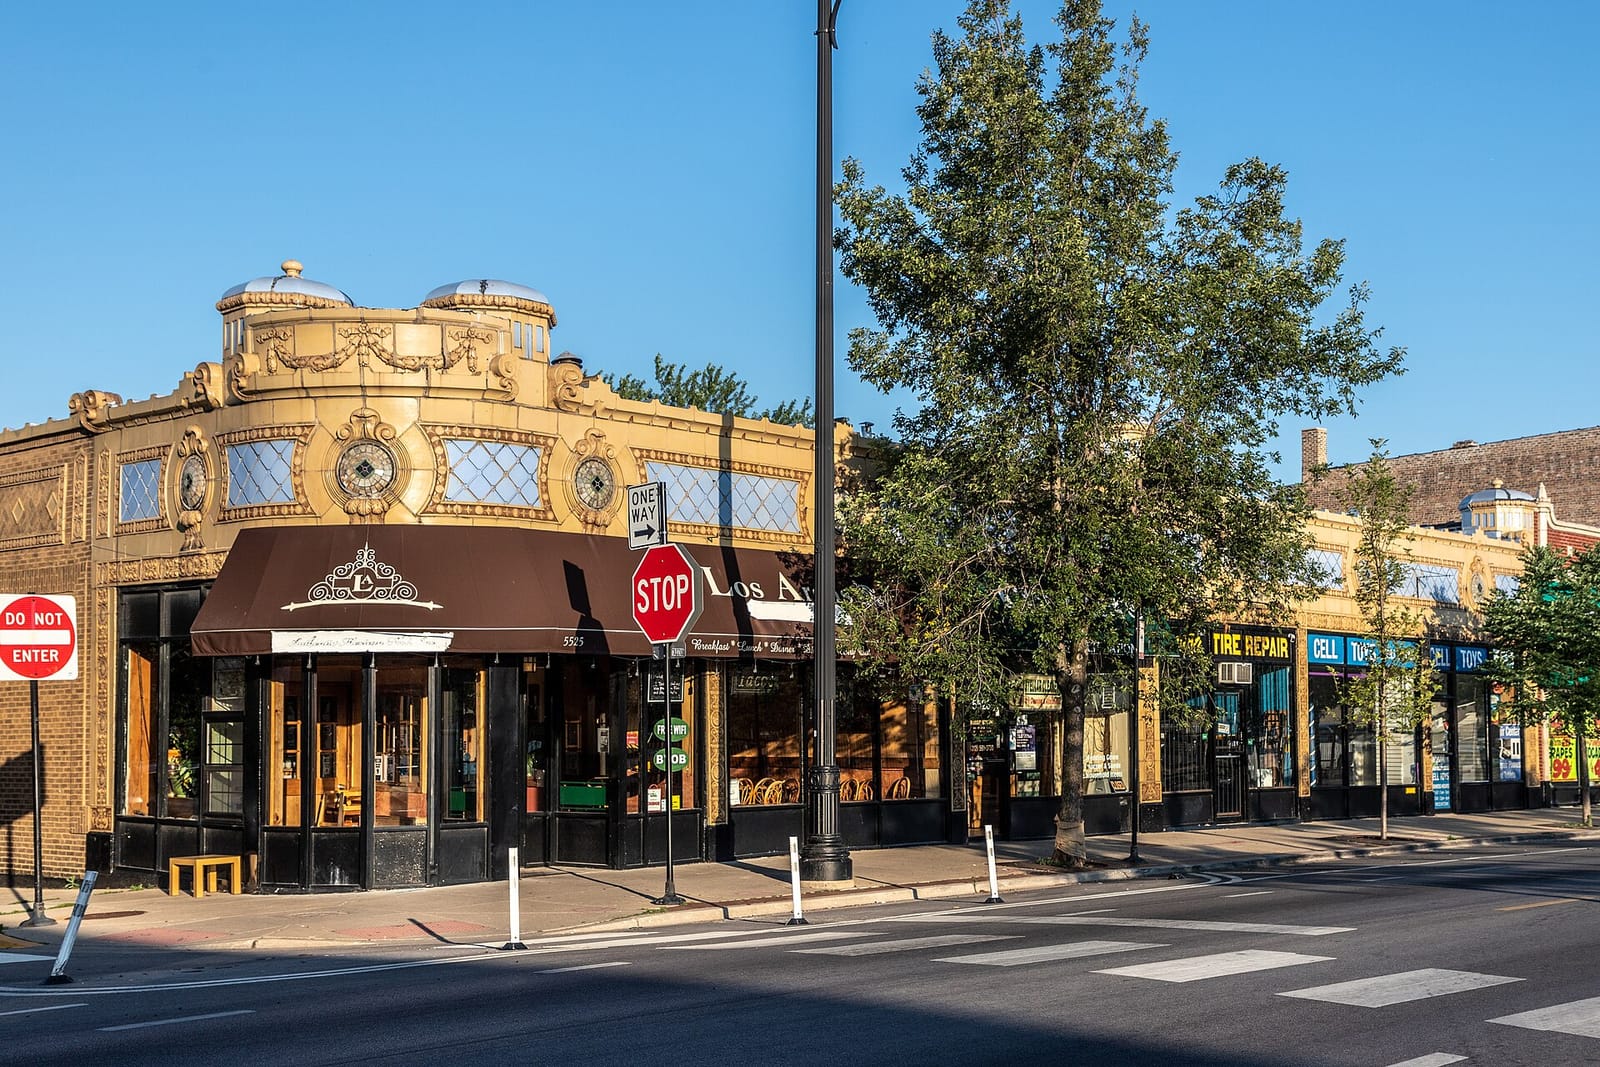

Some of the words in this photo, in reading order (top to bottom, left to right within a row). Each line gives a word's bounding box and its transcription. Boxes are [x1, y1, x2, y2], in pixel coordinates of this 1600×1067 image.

[631, 488, 656, 506] ONE
[631, 505, 656, 524] WAY
[700, 566, 765, 598] Los
[637, 574, 689, 614] STOP
[5, 612, 26, 626] DO
[34, 612, 63, 626] NOT
[562, 635, 584, 648] 5525
[691, 638, 730, 654] Breakfast
[737, 641, 763, 653] Lunch
[770, 642, 796, 654] Dinner
[1213, 633, 1242, 656] TIRE
[1245, 634, 1290, 659] REPAIR
[1313, 638, 1339, 659] CELL
[12, 649, 59, 663] ENTER
[1460, 649, 1483, 669] TOYS
[674, 725, 687, 735] WIFI
[656, 754, 687, 765] BOB
